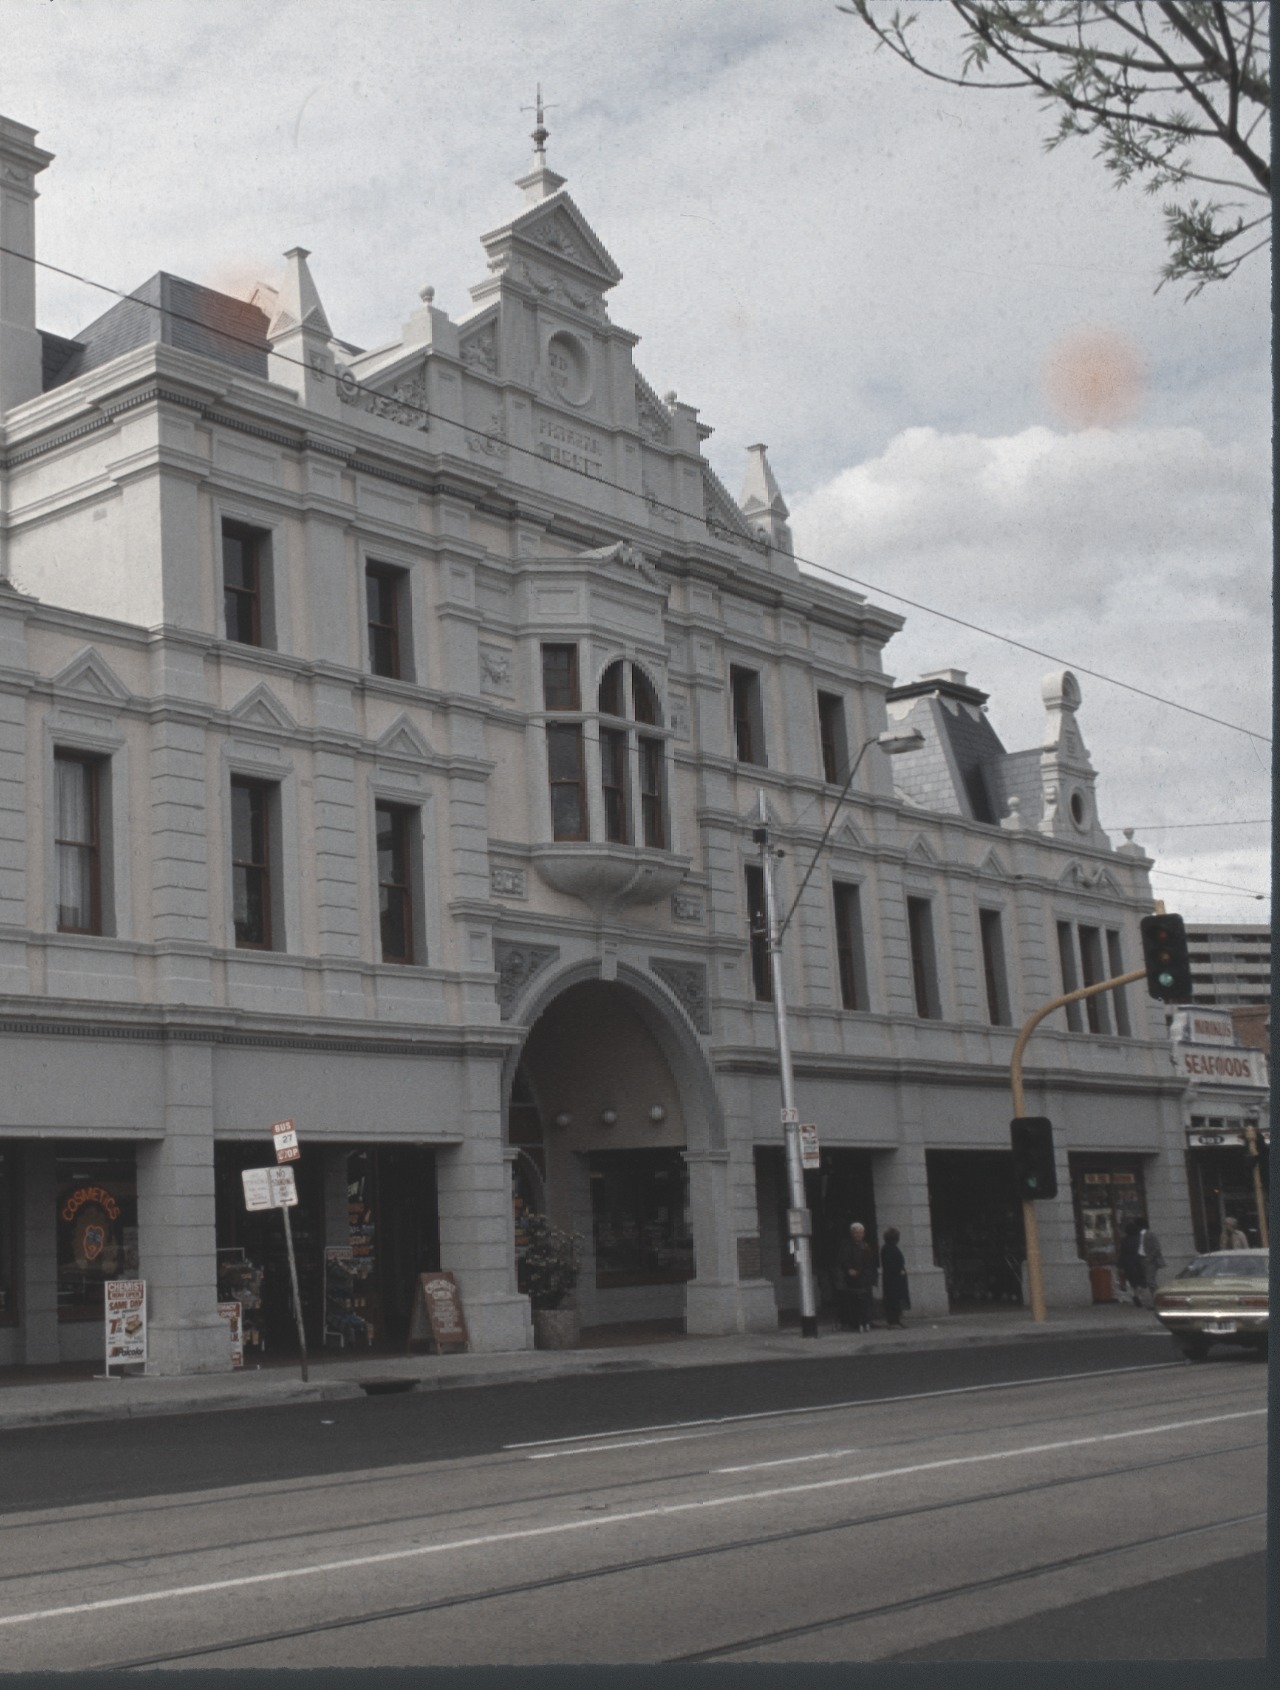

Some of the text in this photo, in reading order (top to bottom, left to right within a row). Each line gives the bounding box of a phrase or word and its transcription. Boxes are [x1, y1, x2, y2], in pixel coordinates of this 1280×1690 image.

[1184, 1054, 1251, 1078] SEAFOODS
[274, 1121, 292, 1133] BUS
[282, 1134, 293, 1144] 27
[278, 1148, 299, 1160] STOP
[61, 1187, 121, 1222] COSMETICS
[108, 1282, 143, 1292] CHEMIST
[109, 1299, 143, 1311] SAME DAY
